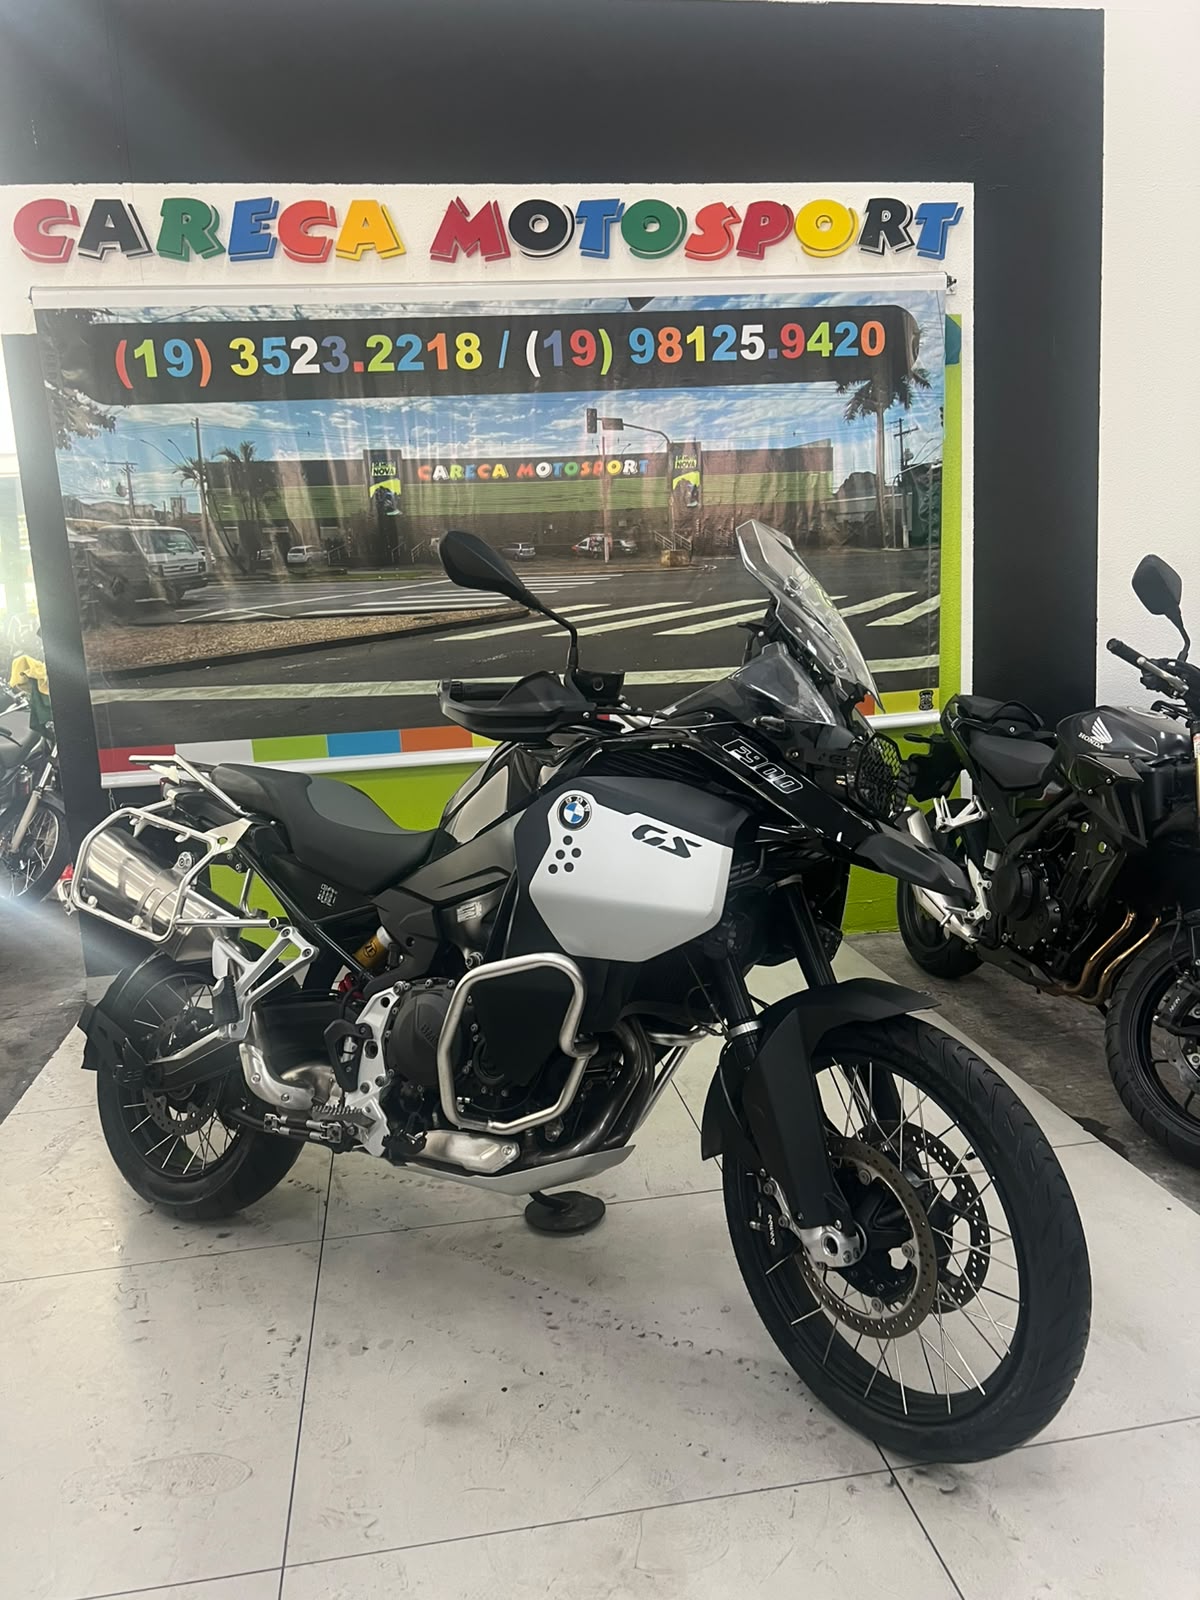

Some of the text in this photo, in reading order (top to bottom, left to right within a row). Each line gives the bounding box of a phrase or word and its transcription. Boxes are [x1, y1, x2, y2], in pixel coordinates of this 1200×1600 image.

[13, 196, 965, 263] CARECA MOTOSPORT
[115, 320, 886, 388] (19) 3523.2218 / (19) 98125.9420
[417, 459, 650, 481] CARECA MOTOSPORT
[1078, 732, 1104, 750] HONDA
[565, 796, 591, 812] BMW
[631, 823, 703, 858] GS
